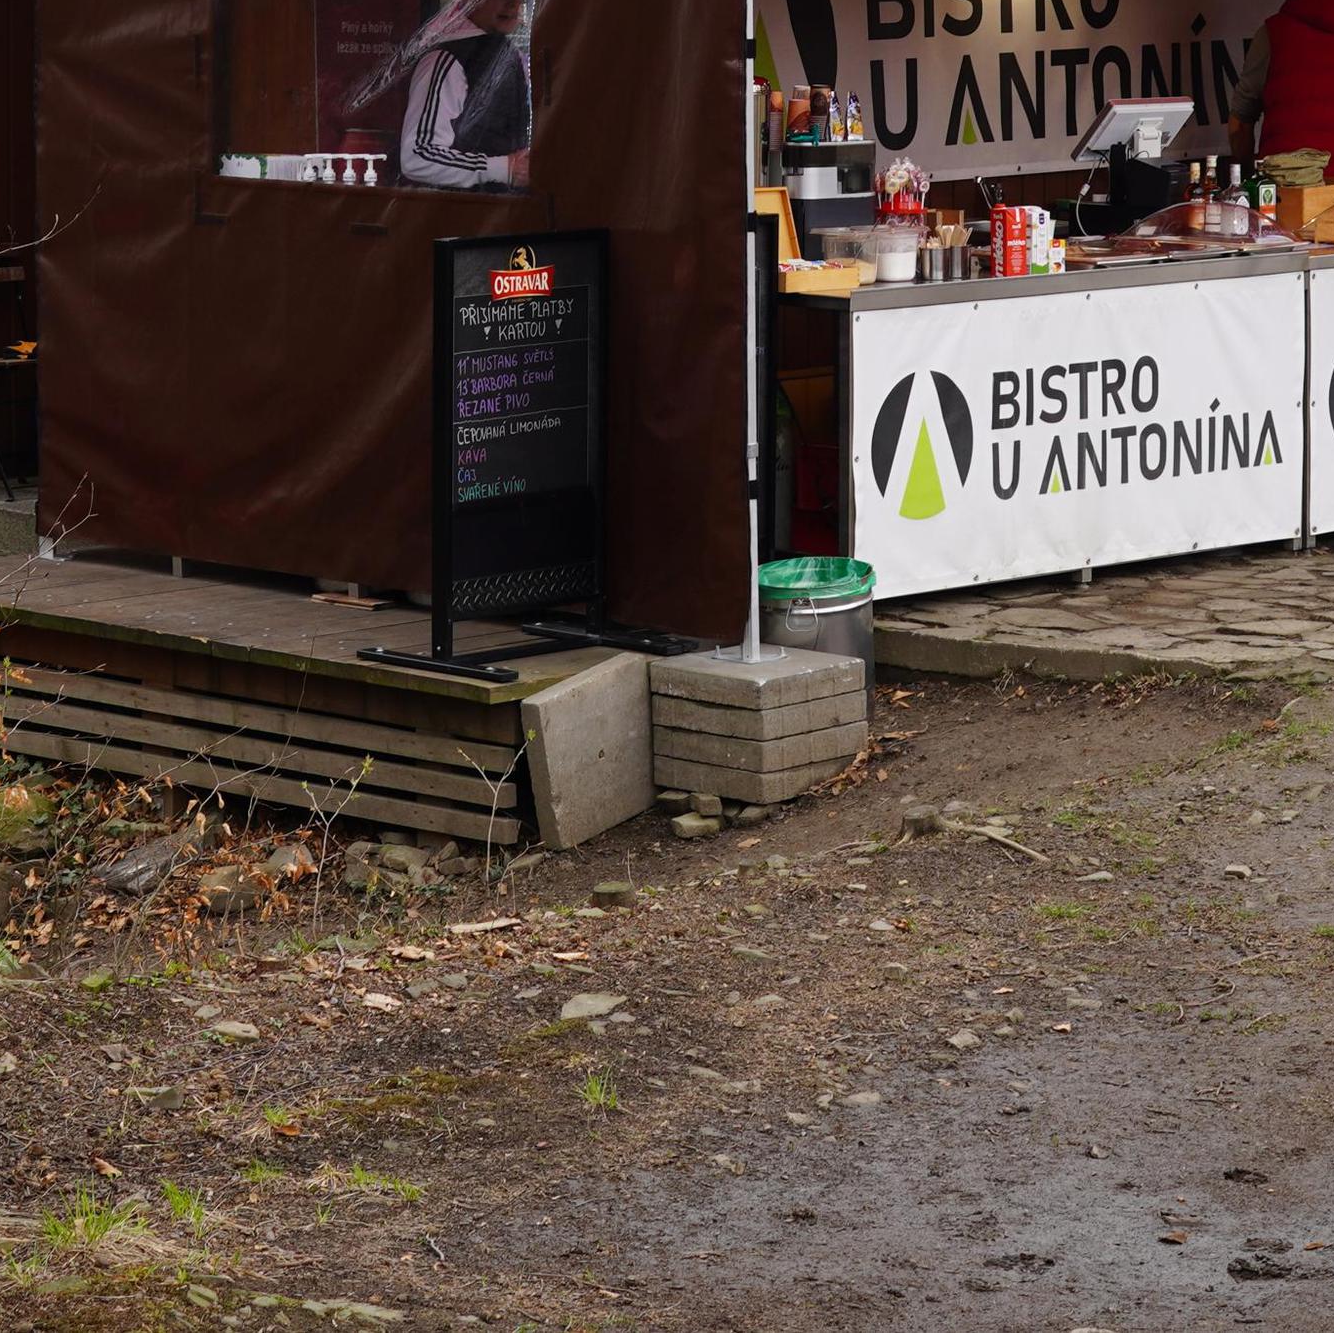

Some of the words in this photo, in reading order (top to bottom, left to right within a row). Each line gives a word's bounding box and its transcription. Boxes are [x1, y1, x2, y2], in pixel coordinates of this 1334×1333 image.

[869, 57, 919, 151] U
[945, 12, 1255, 147] ANTONÍN
[493, 271, 550, 295] OSTRAVAR
[459, 299, 526, 327] PŘIJÍMÁME
[528, 298, 575, 320] PLATBY
[497, 320, 547, 342] KARTOU
[471, 353, 518, 374] MUSTANG
[470, 372, 518, 395] BARBORA
[521, 366, 556, 386] ČERNÁ
[990, 354, 1160, 431] BISTRO
[456, 393, 502, 419] ŘEZANÉ
[505, 392, 531, 411] PIVO
[456, 421, 507, 446] ČEPOVANÁ
[509, 415, 563, 436] LIMONÁDA
[457, 445, 488, 467] KÁVA
[991, 439, 1022, 501] U
[1038, 396, 1284, 496] ANTONÍNA
[456, 467, 478, 484] ČAJ
[457, 477, 501, 503] SVAŘENÉ
[502, 475, 527, 494] VÍNO
